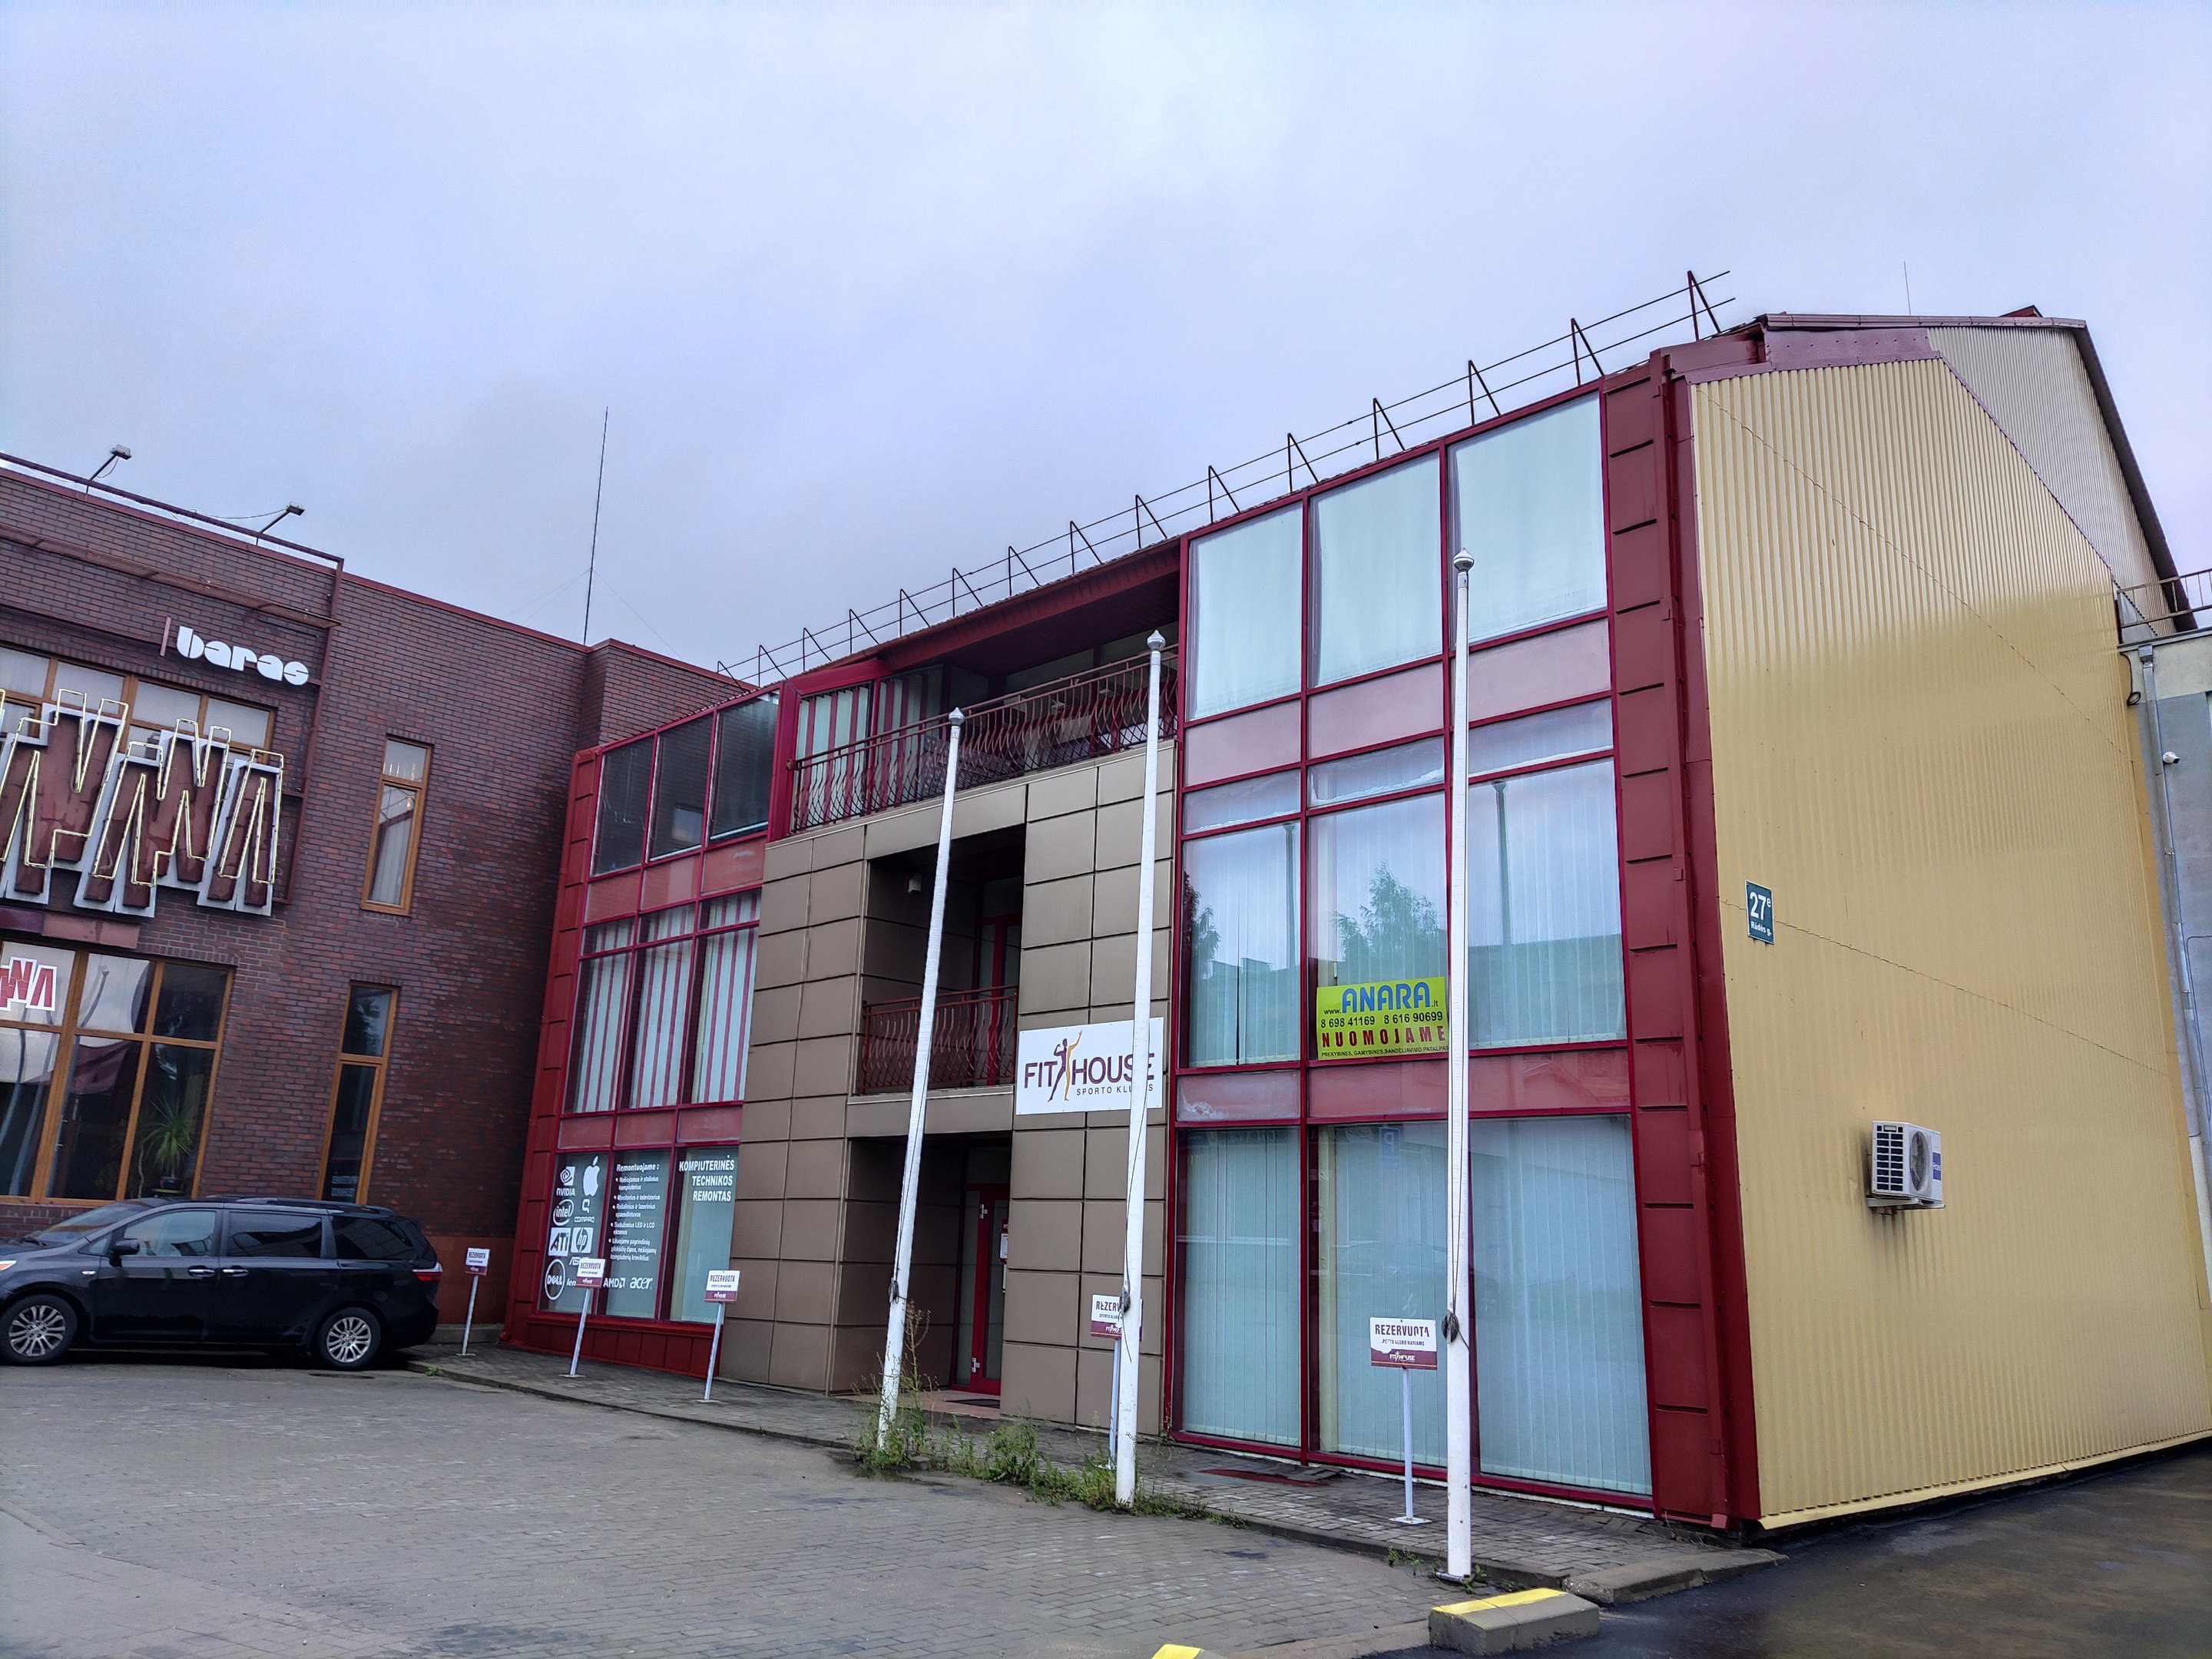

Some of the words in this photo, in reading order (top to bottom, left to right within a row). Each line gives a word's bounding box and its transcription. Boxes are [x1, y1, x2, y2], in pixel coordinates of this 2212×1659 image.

[177, 626, 309, 685] baras
[1320, 1018, 1326, 1028] 8
[1329, 1018, 1345, 1028] 698
[1347, 1015, 1375, 1027] 41169
[1384, 1014, 1389, 1025] 8
[1392, 1012, 1410, 1024] 616
[1413, 1011, 1443, 1022] 90699
[1322, 1025, 1445, 1048] NUOMOJAME
[1024, 1061, 1058, 1088] FIT
[1076, 1086, 1112, 1095] SPORTO
[617, 1163, 656, 1172] Remontuojame
[679, 1154, 734, 1172] KOMPIUTERINĖS
[692, 1175, 733, 1186] TECHNIKOS
[693, 1190, 731, 1201] REMONTAS
[555, 1205, 571, 1217] intel
[547, 1275, 562, 1285] DELL
[603, 1277, 619, 1288] AMD
[630, 1277, 653, 1290] acer
